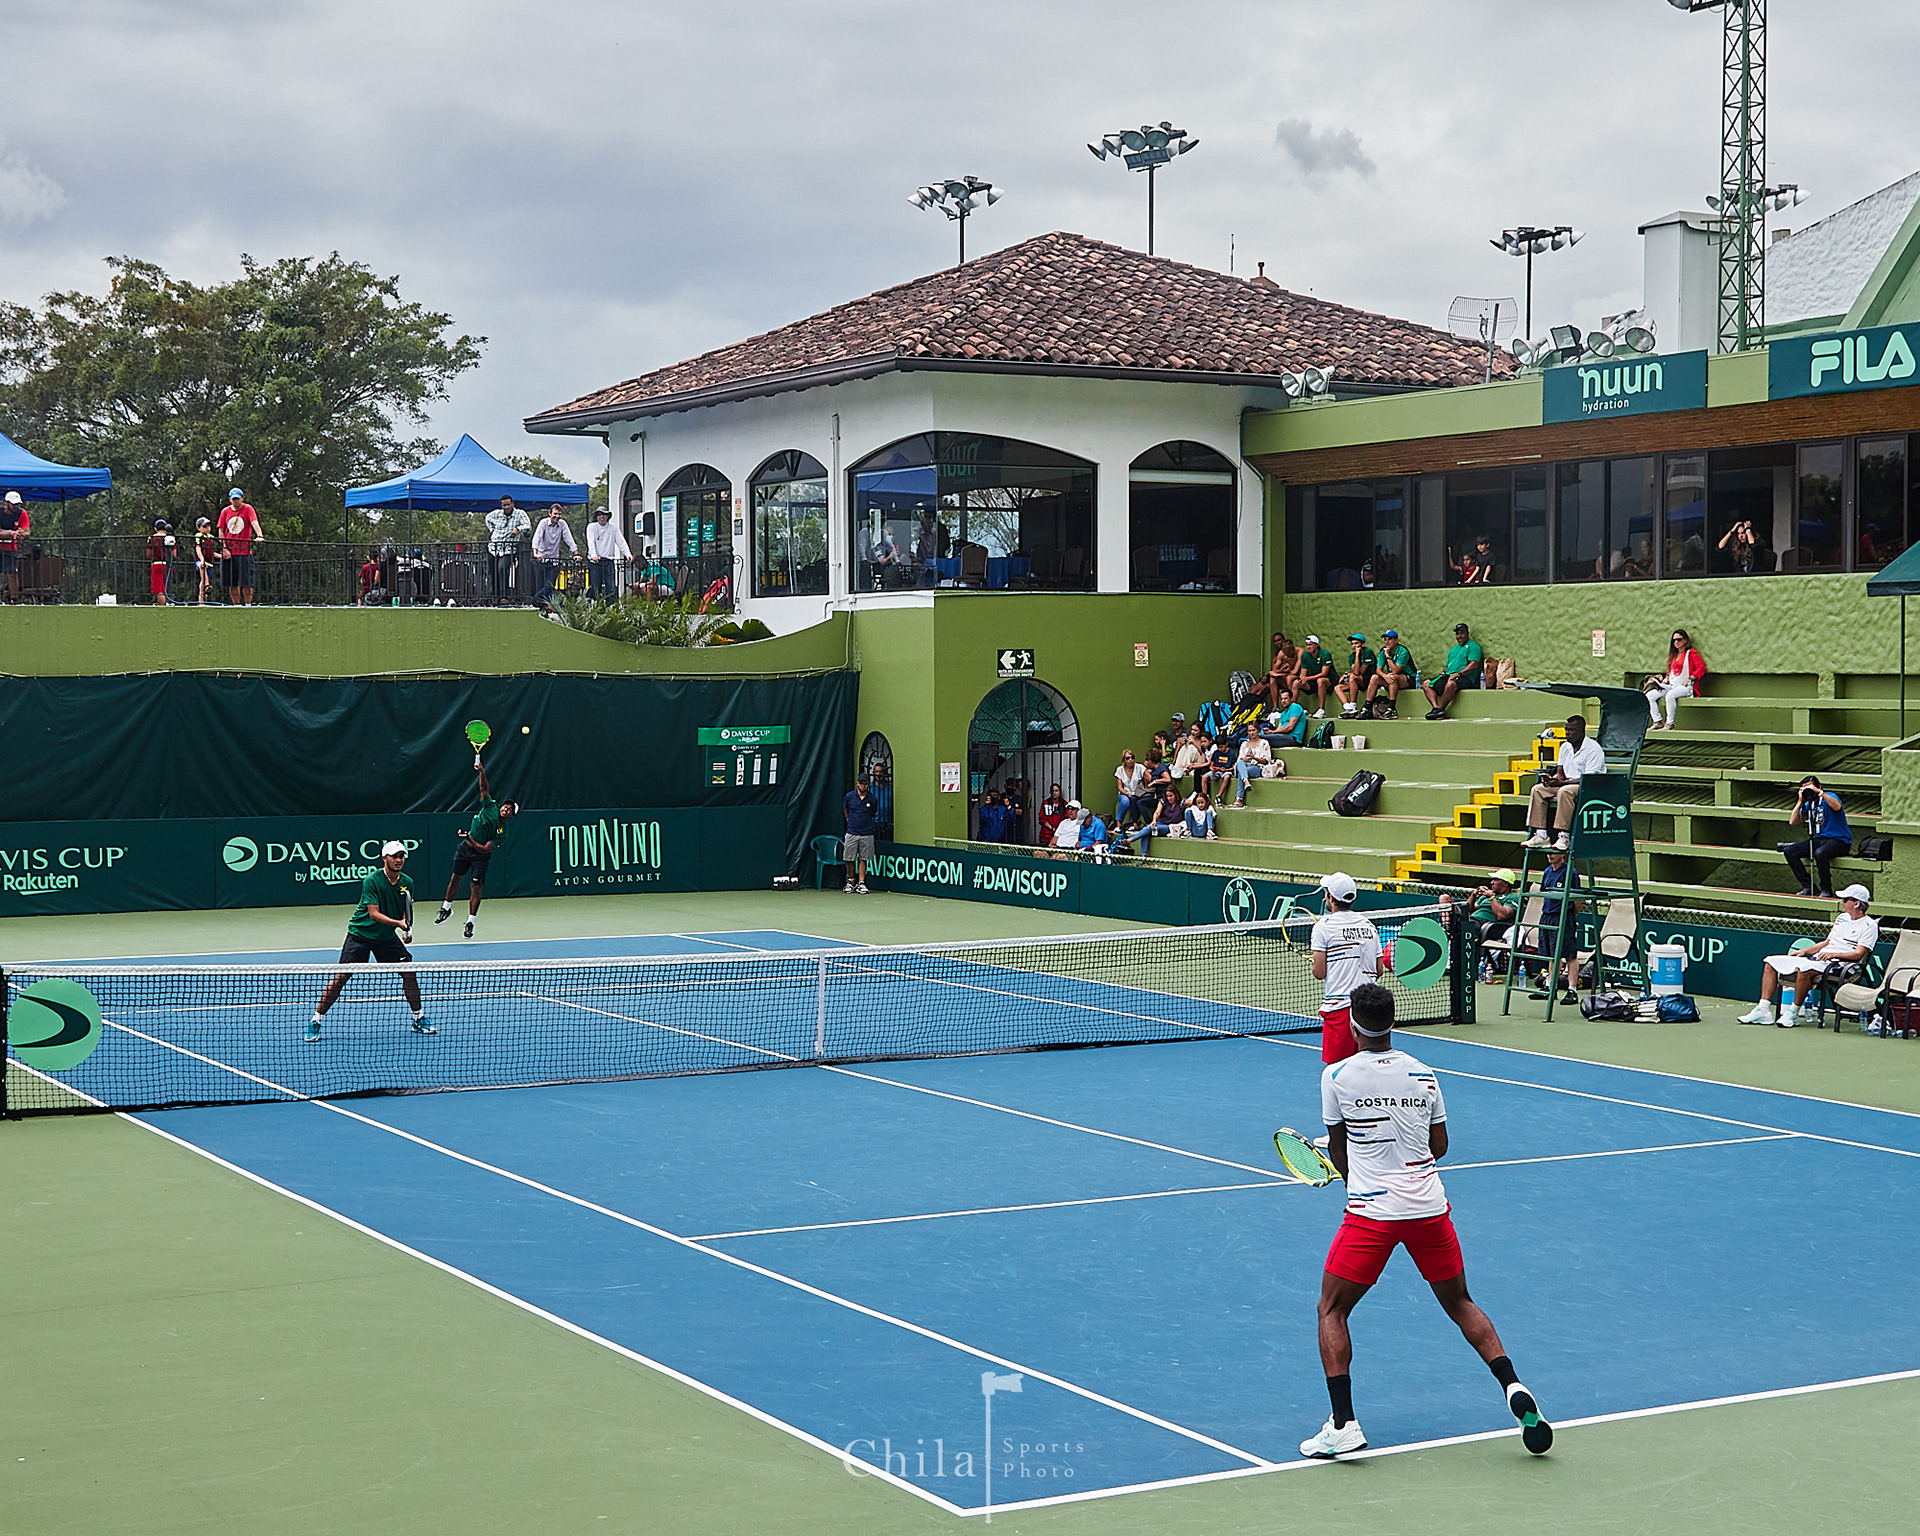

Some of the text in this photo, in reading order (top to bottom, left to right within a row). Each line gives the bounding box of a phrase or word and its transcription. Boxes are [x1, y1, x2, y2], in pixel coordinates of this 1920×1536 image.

[1811, 331, 1916, 387] FILA
[1577, 362, 1663, 399] nuun
[1582, 398, 1629, 415] hydration
[738, 775, 743, 783] 2
[1583, 810, 1613, 829] ITF
[266, 838, 420, 863] DAVIS CP
[549, 818, 661, 874] TONNINO
[0, 847, 125, 871] VIS CUP
[3, 872, 79, 891] Rakuten
[295, 871, 307, 883] by
[554, 873, 662, 886] ATÚN GOURMET
[855, 852, 1068, 898] AVISCUP.COM #DAVISCUP
[1227, 880, 1252, 897] BMW
[1355, 1097, 1428, 1108] COSTA RICA
